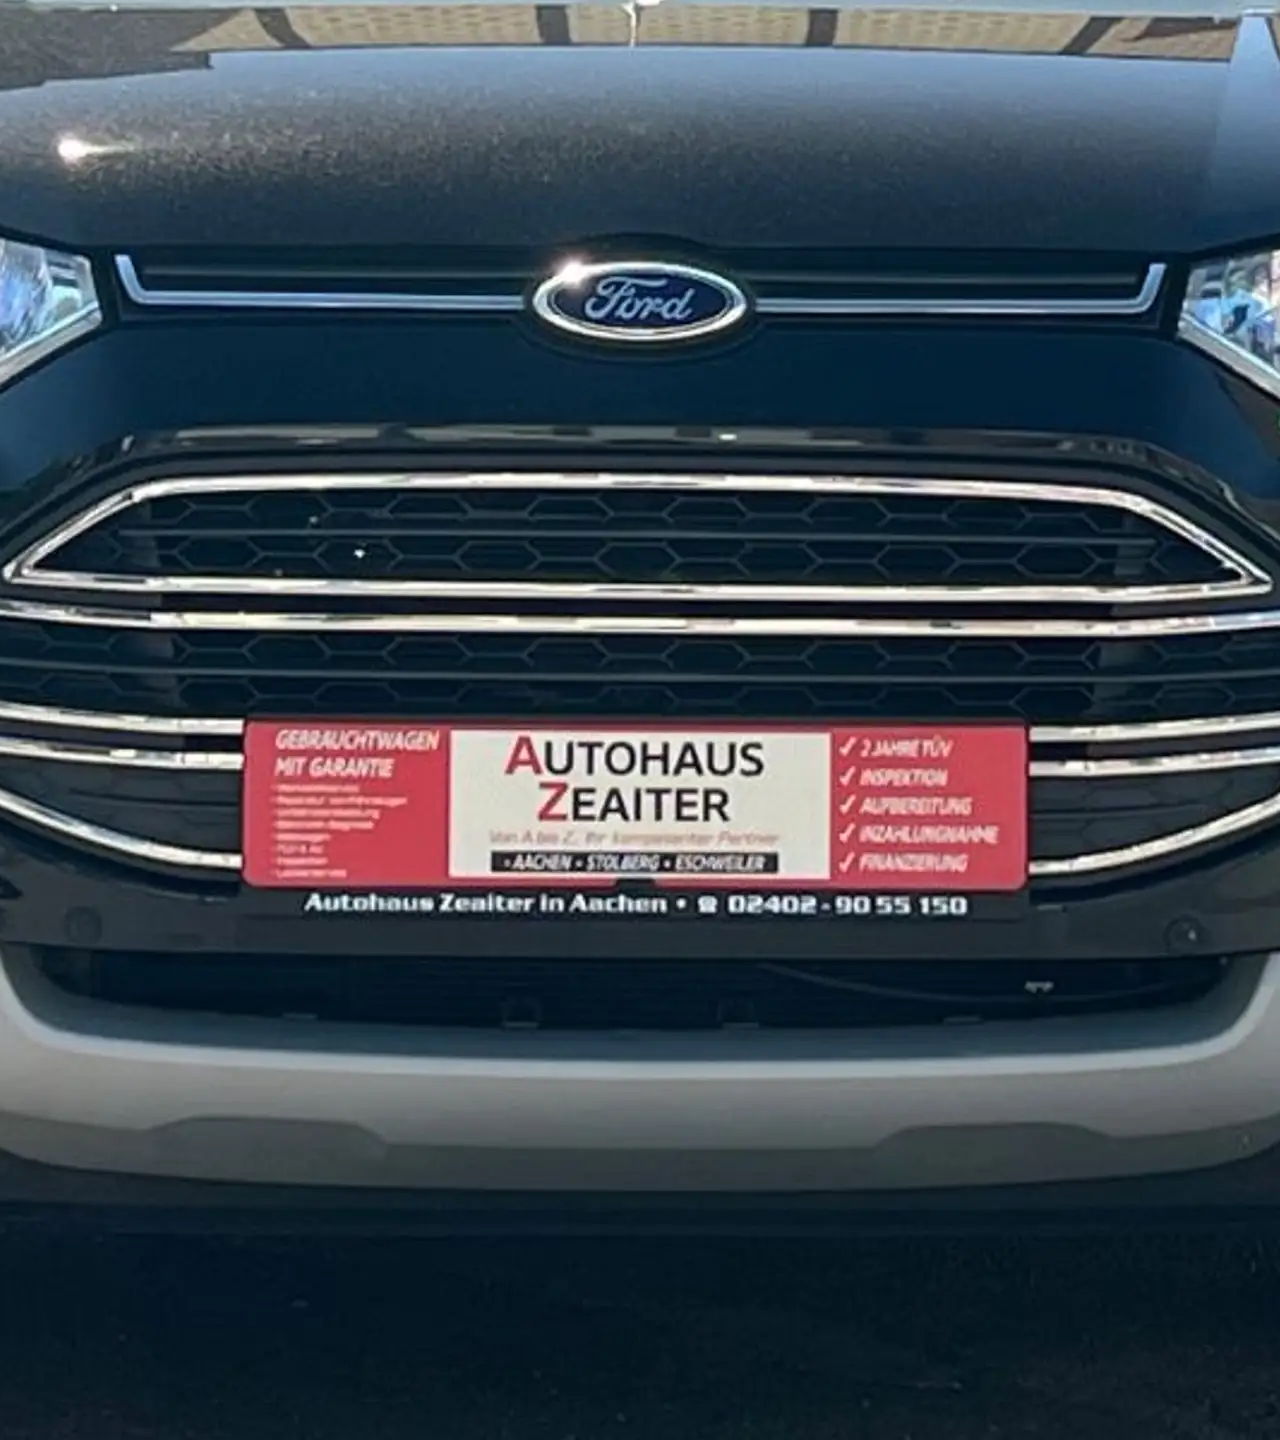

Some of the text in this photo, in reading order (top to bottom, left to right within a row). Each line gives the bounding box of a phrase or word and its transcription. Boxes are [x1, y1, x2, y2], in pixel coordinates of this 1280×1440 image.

[584, 276, 696, 320] Ford
[275, 729, 440, 750] GEBRAUCHTWAGEN
[860, 735, 954, 758] 2 JAHRE TÜV
[504, 736, 764, 777] AUTOHAUS
[275, 757, 395, 778] MIT GARANTIE
[859, 768, 949, 787] INSPEKTION
[537, 782, 730, 822] ZEAITER
[859, 797, 973, 815] AUFBEREITUNG
[512, 854, 767, 872] AACHEN STOLBERG ESCHWEILER
[859, 853, 969, 872] FINANZIERUNG
[304, 892, 434, 911] Autohaus
[438, 893, 534, 912] Zeaiter
[539, 893, 564, 912] in
[570, 893, 667, 913] Aachen
[875, 896, 911, 915] 55
[920, 896, 968, 915] 150
